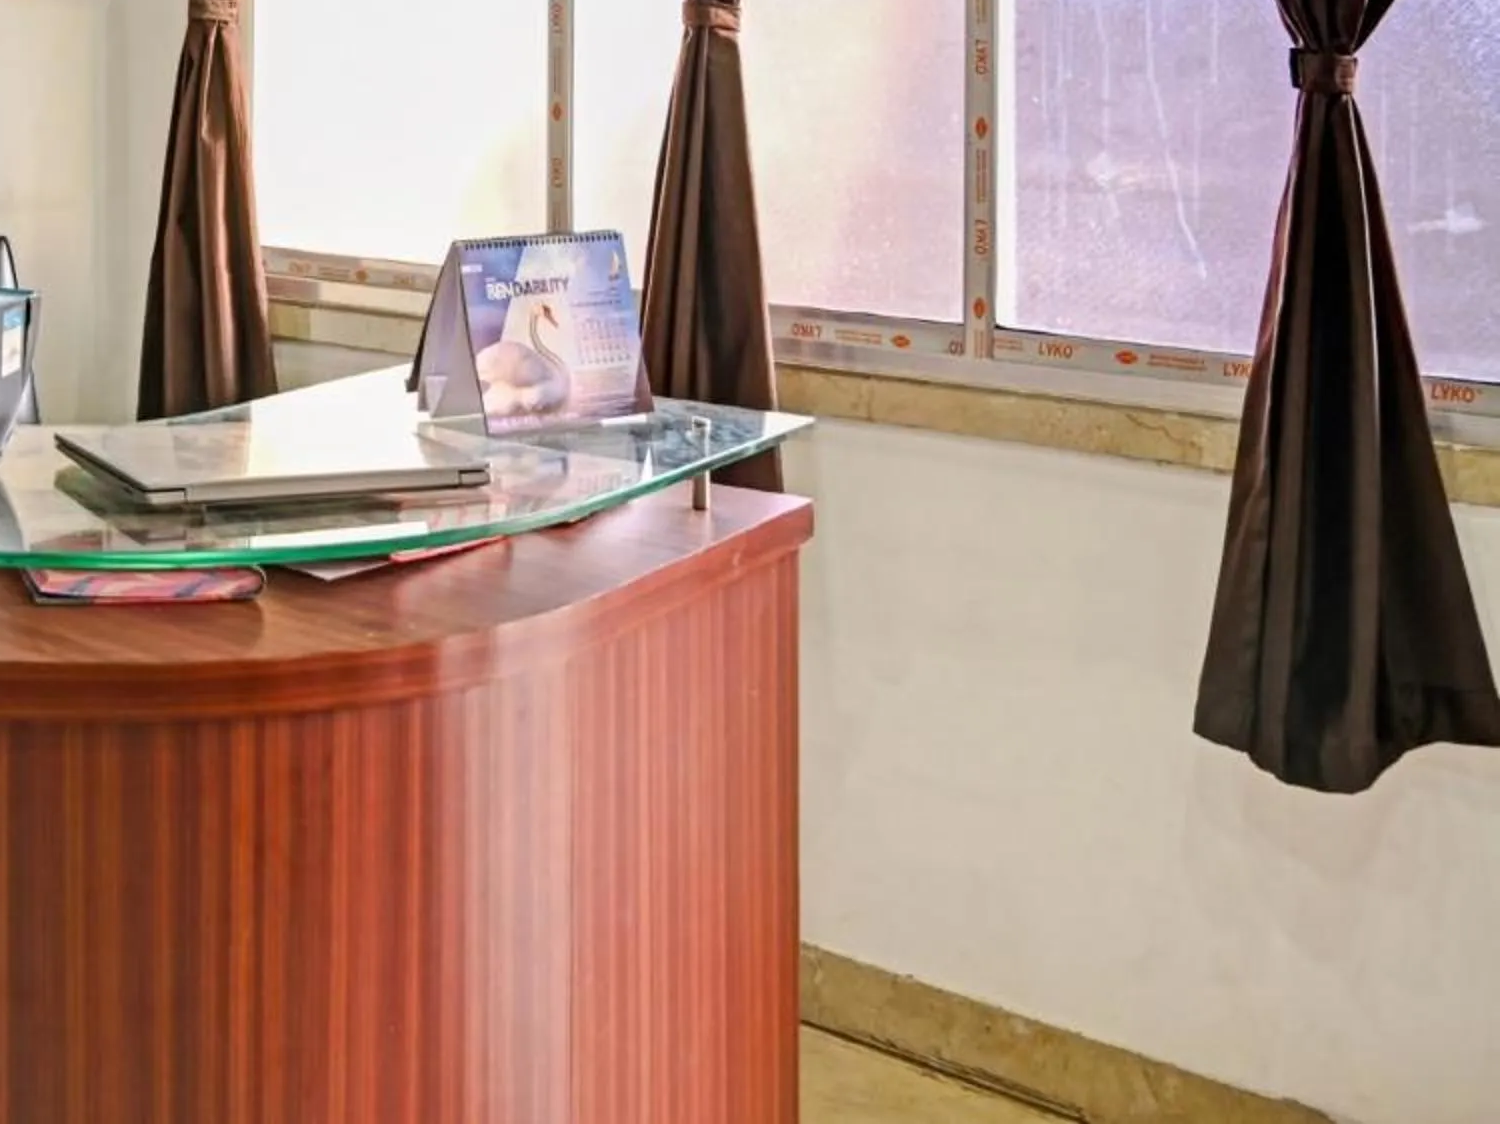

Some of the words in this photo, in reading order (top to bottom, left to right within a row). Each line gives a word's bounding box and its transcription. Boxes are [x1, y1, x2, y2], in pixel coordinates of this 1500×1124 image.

[974, 39, 988, 75] LYKO
[973, 219, 987, 255] LYKO
[791, 323, 822, 339] LYKO
[1038, 341, 1073, 360] LYKO
[1222, 361, 1252, 379] LYK
[1431, 383, 1475, 403] LYKO
